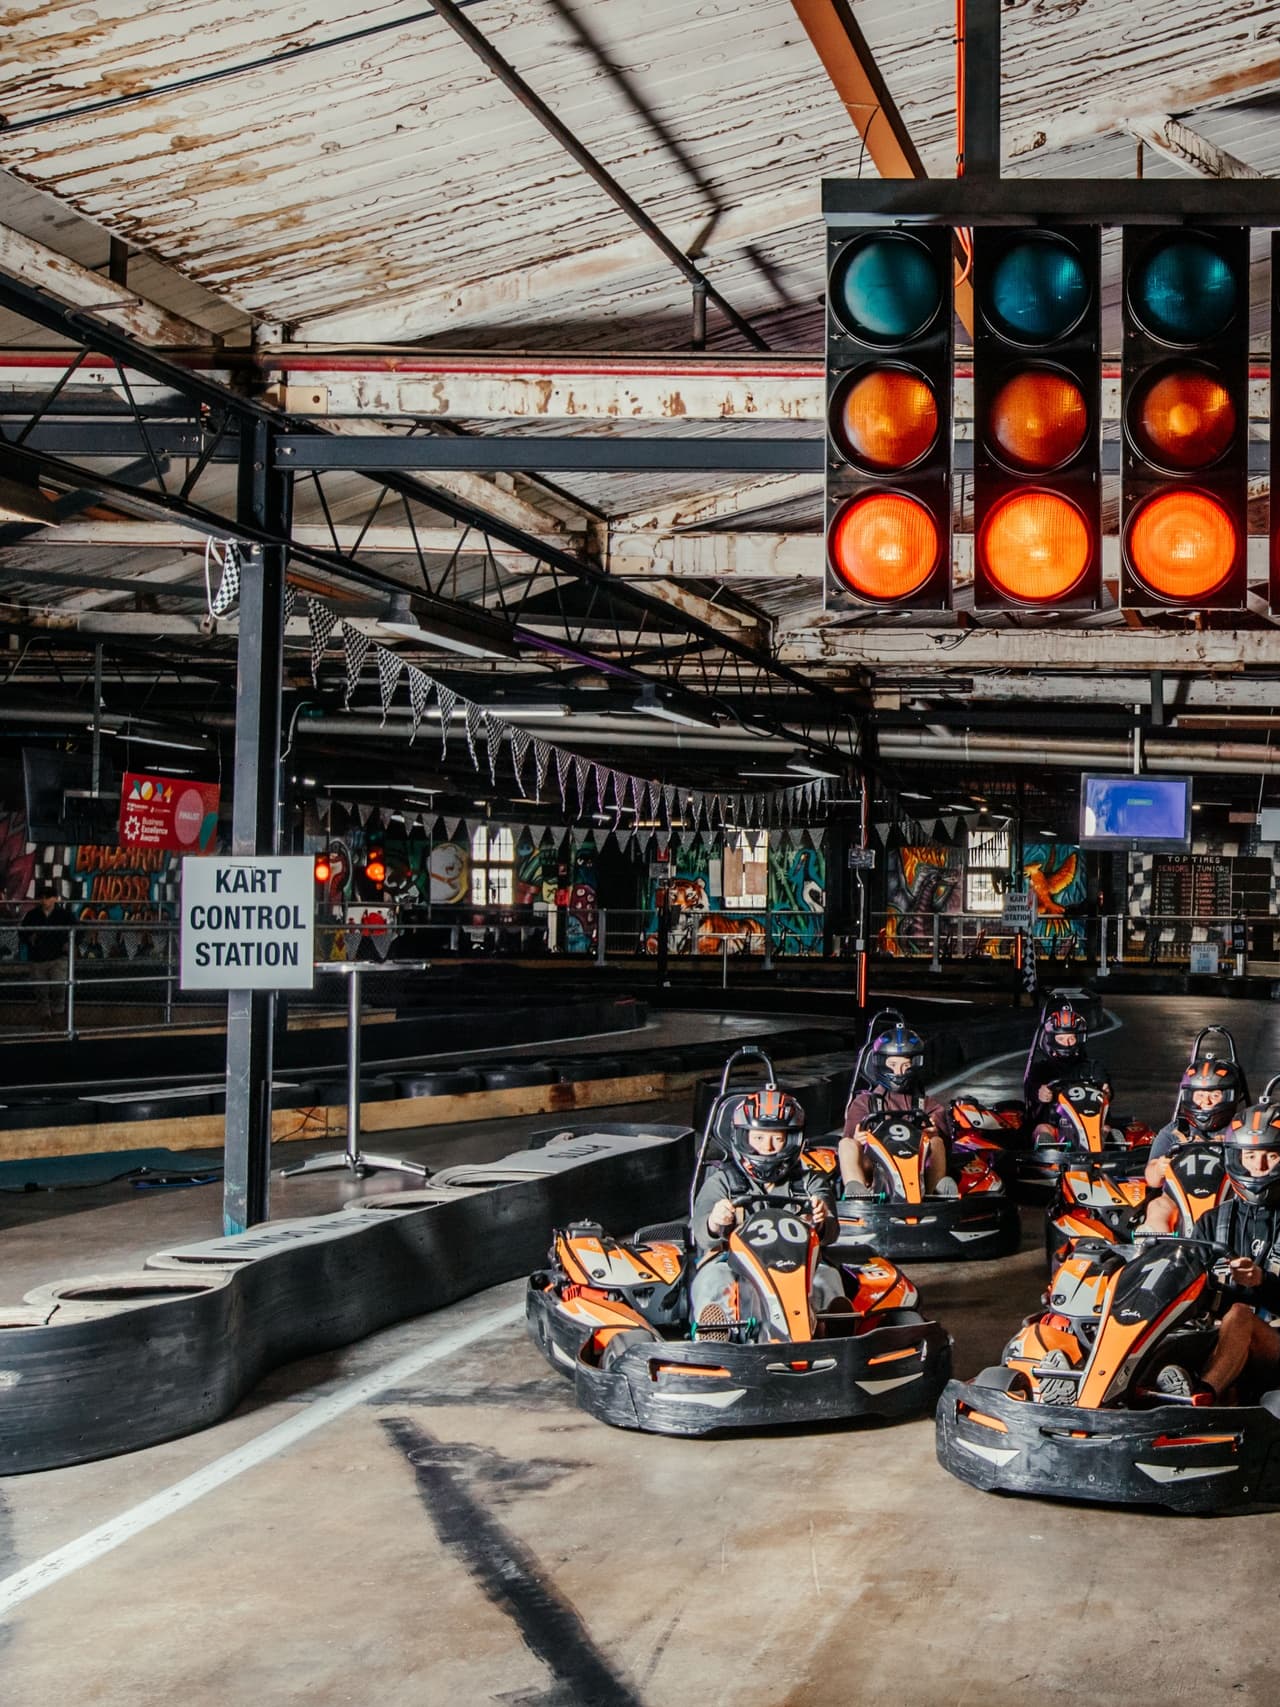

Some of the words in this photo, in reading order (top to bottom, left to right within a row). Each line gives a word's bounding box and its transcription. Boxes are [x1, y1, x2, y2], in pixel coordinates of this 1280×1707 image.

[141, 826, 169, 836] Excellence
[1192, 856, 1221, 864] TIMES
[1197, 864, 1230, 873] JUNIORS
[215, 868, 282, 894] KART
[189, 904, 307, 931] CONTROL
[194, 941, 299, 967] STATION
[1068, 1086, 1104, 1101] 97
[889, 1124, 911, 1141] 9
[1179, 1154, 1220, 1176] 17
[746, 1218, 808, 1246] 30
[1141, 1258, 1171, 1290] 1
